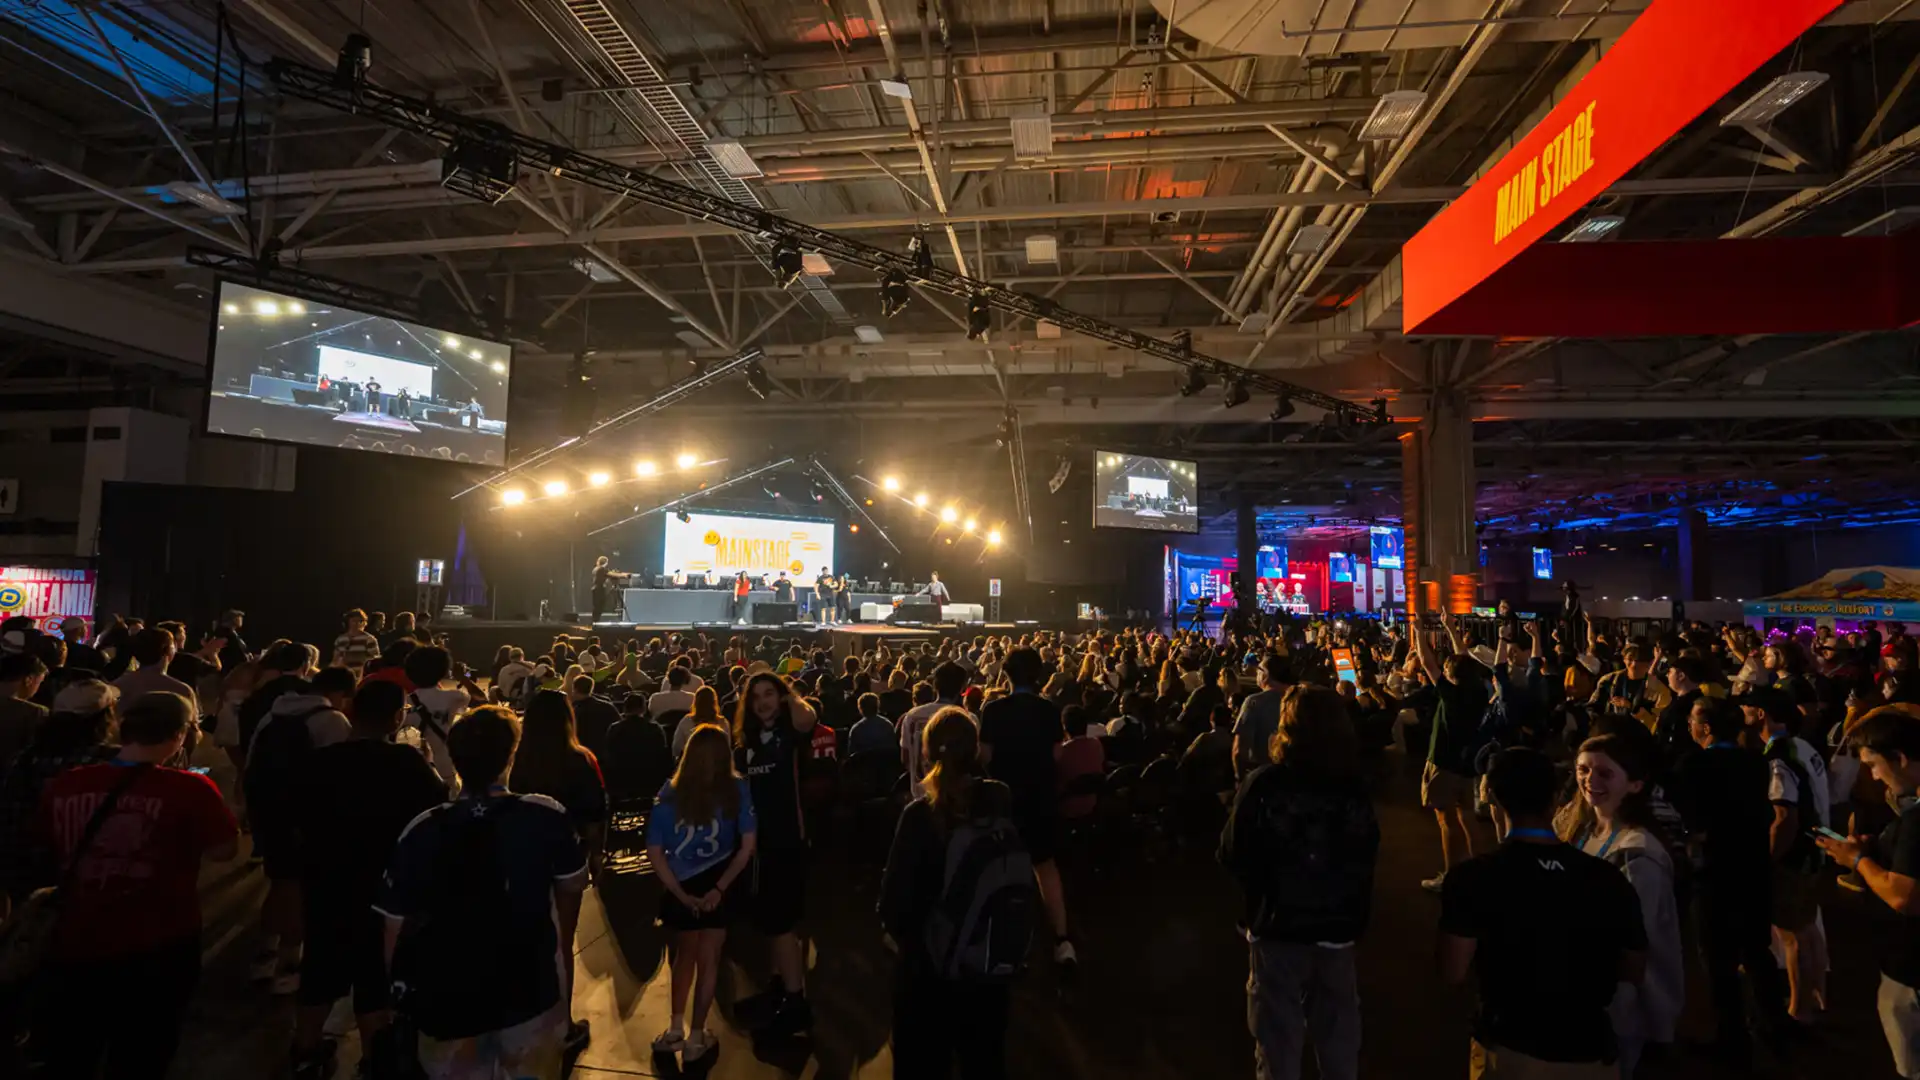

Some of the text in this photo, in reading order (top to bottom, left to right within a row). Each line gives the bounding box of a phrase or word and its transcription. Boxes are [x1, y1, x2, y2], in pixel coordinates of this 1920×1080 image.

[1494, 99, 1597, 245] MAIN STAGE
[715, 536, 791, 569] MAINSTAGE
[674, 817, 720, 859] 23
